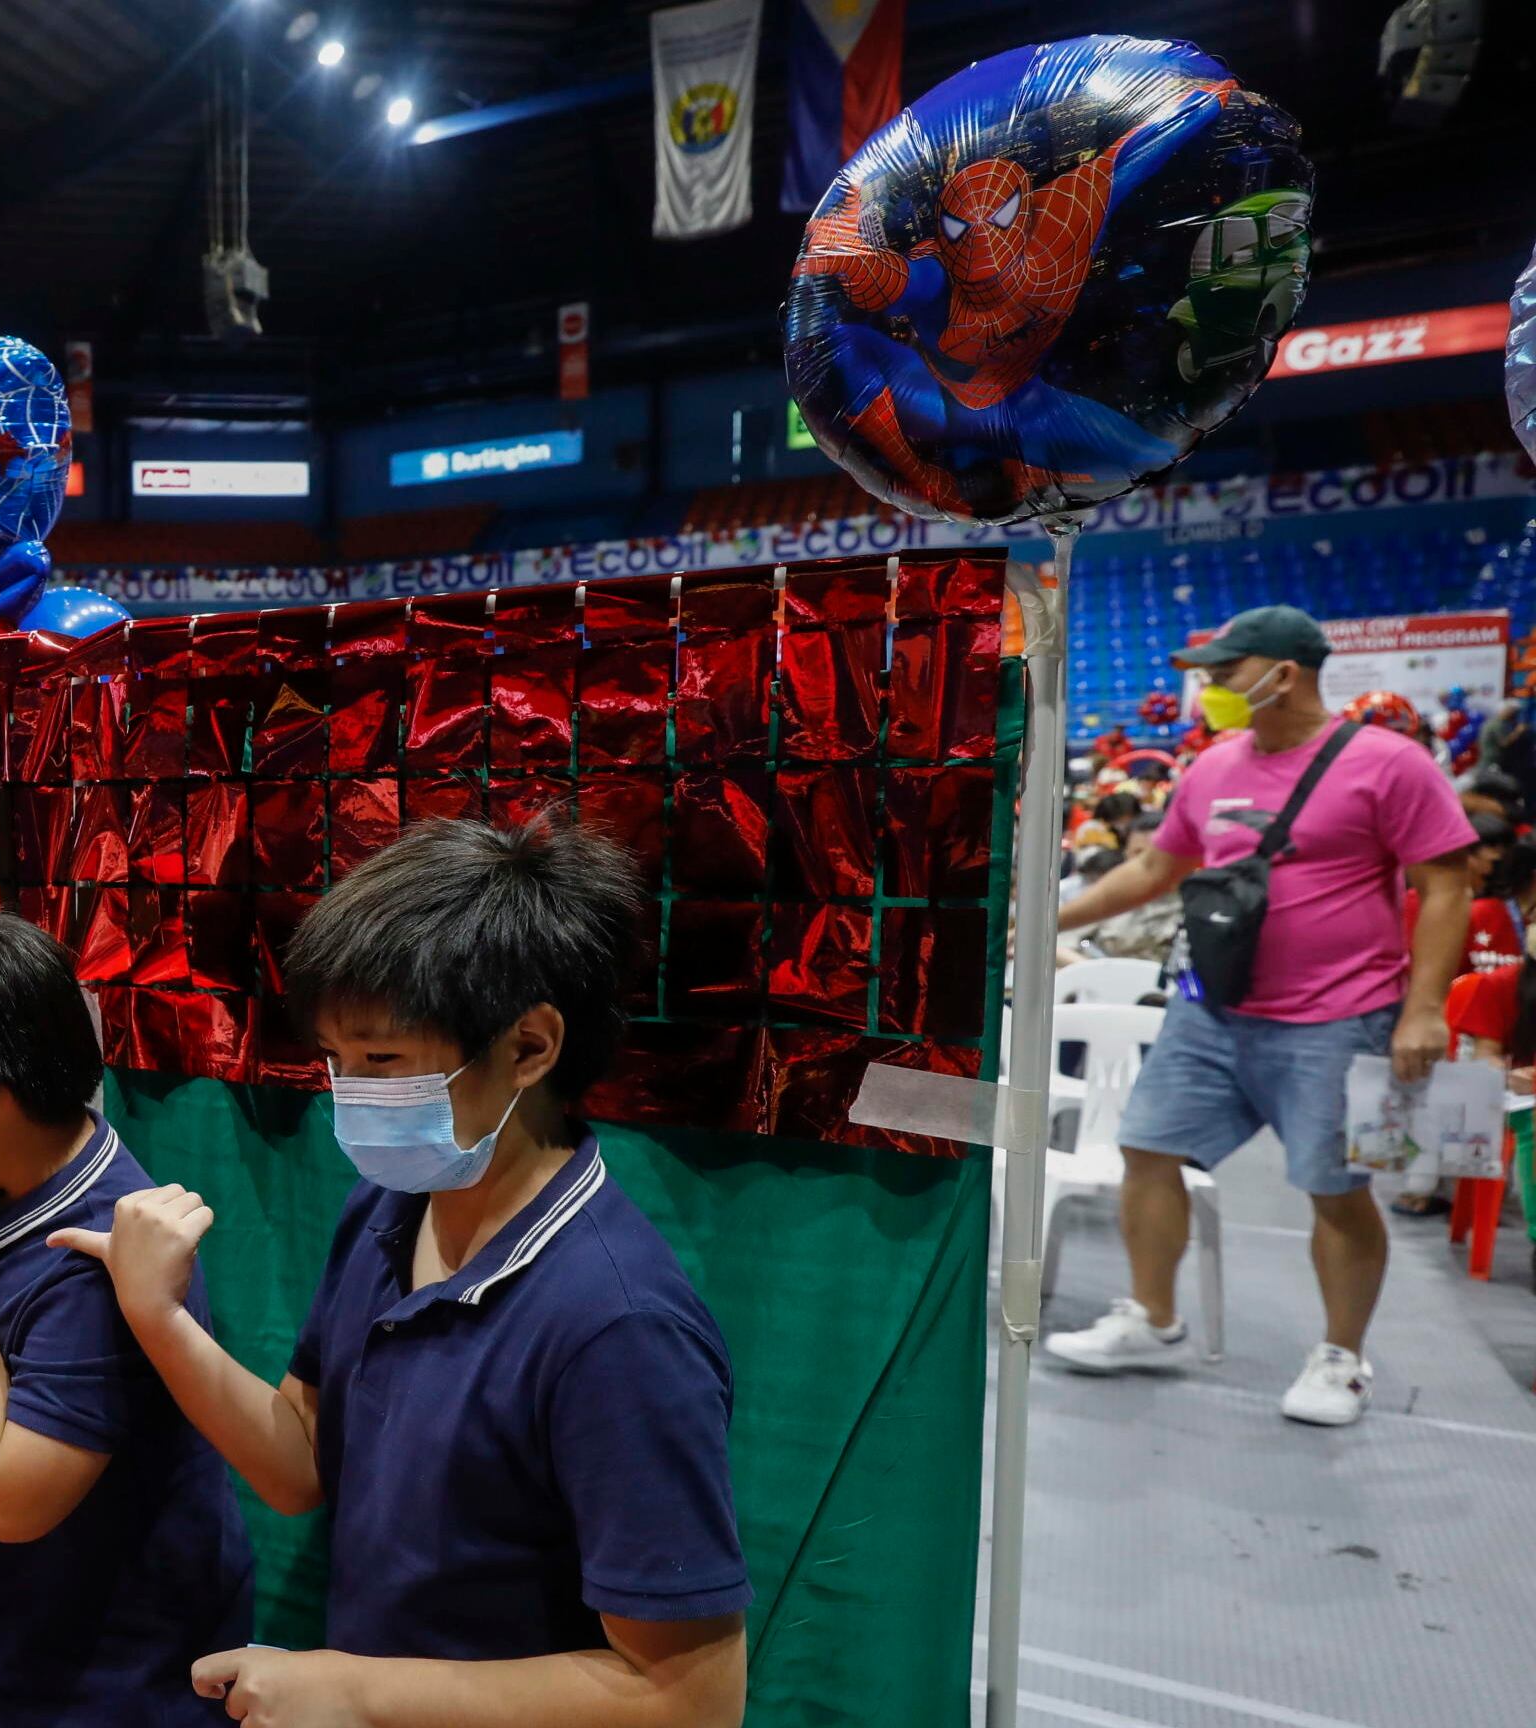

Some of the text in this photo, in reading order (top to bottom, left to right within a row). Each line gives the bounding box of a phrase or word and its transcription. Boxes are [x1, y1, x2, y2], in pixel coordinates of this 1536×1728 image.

[1285, 326, 1426, 371] Gazz
[451, 443, 551, 472] Burlington
[1400, 627, 1500, 648] PROGRAM
